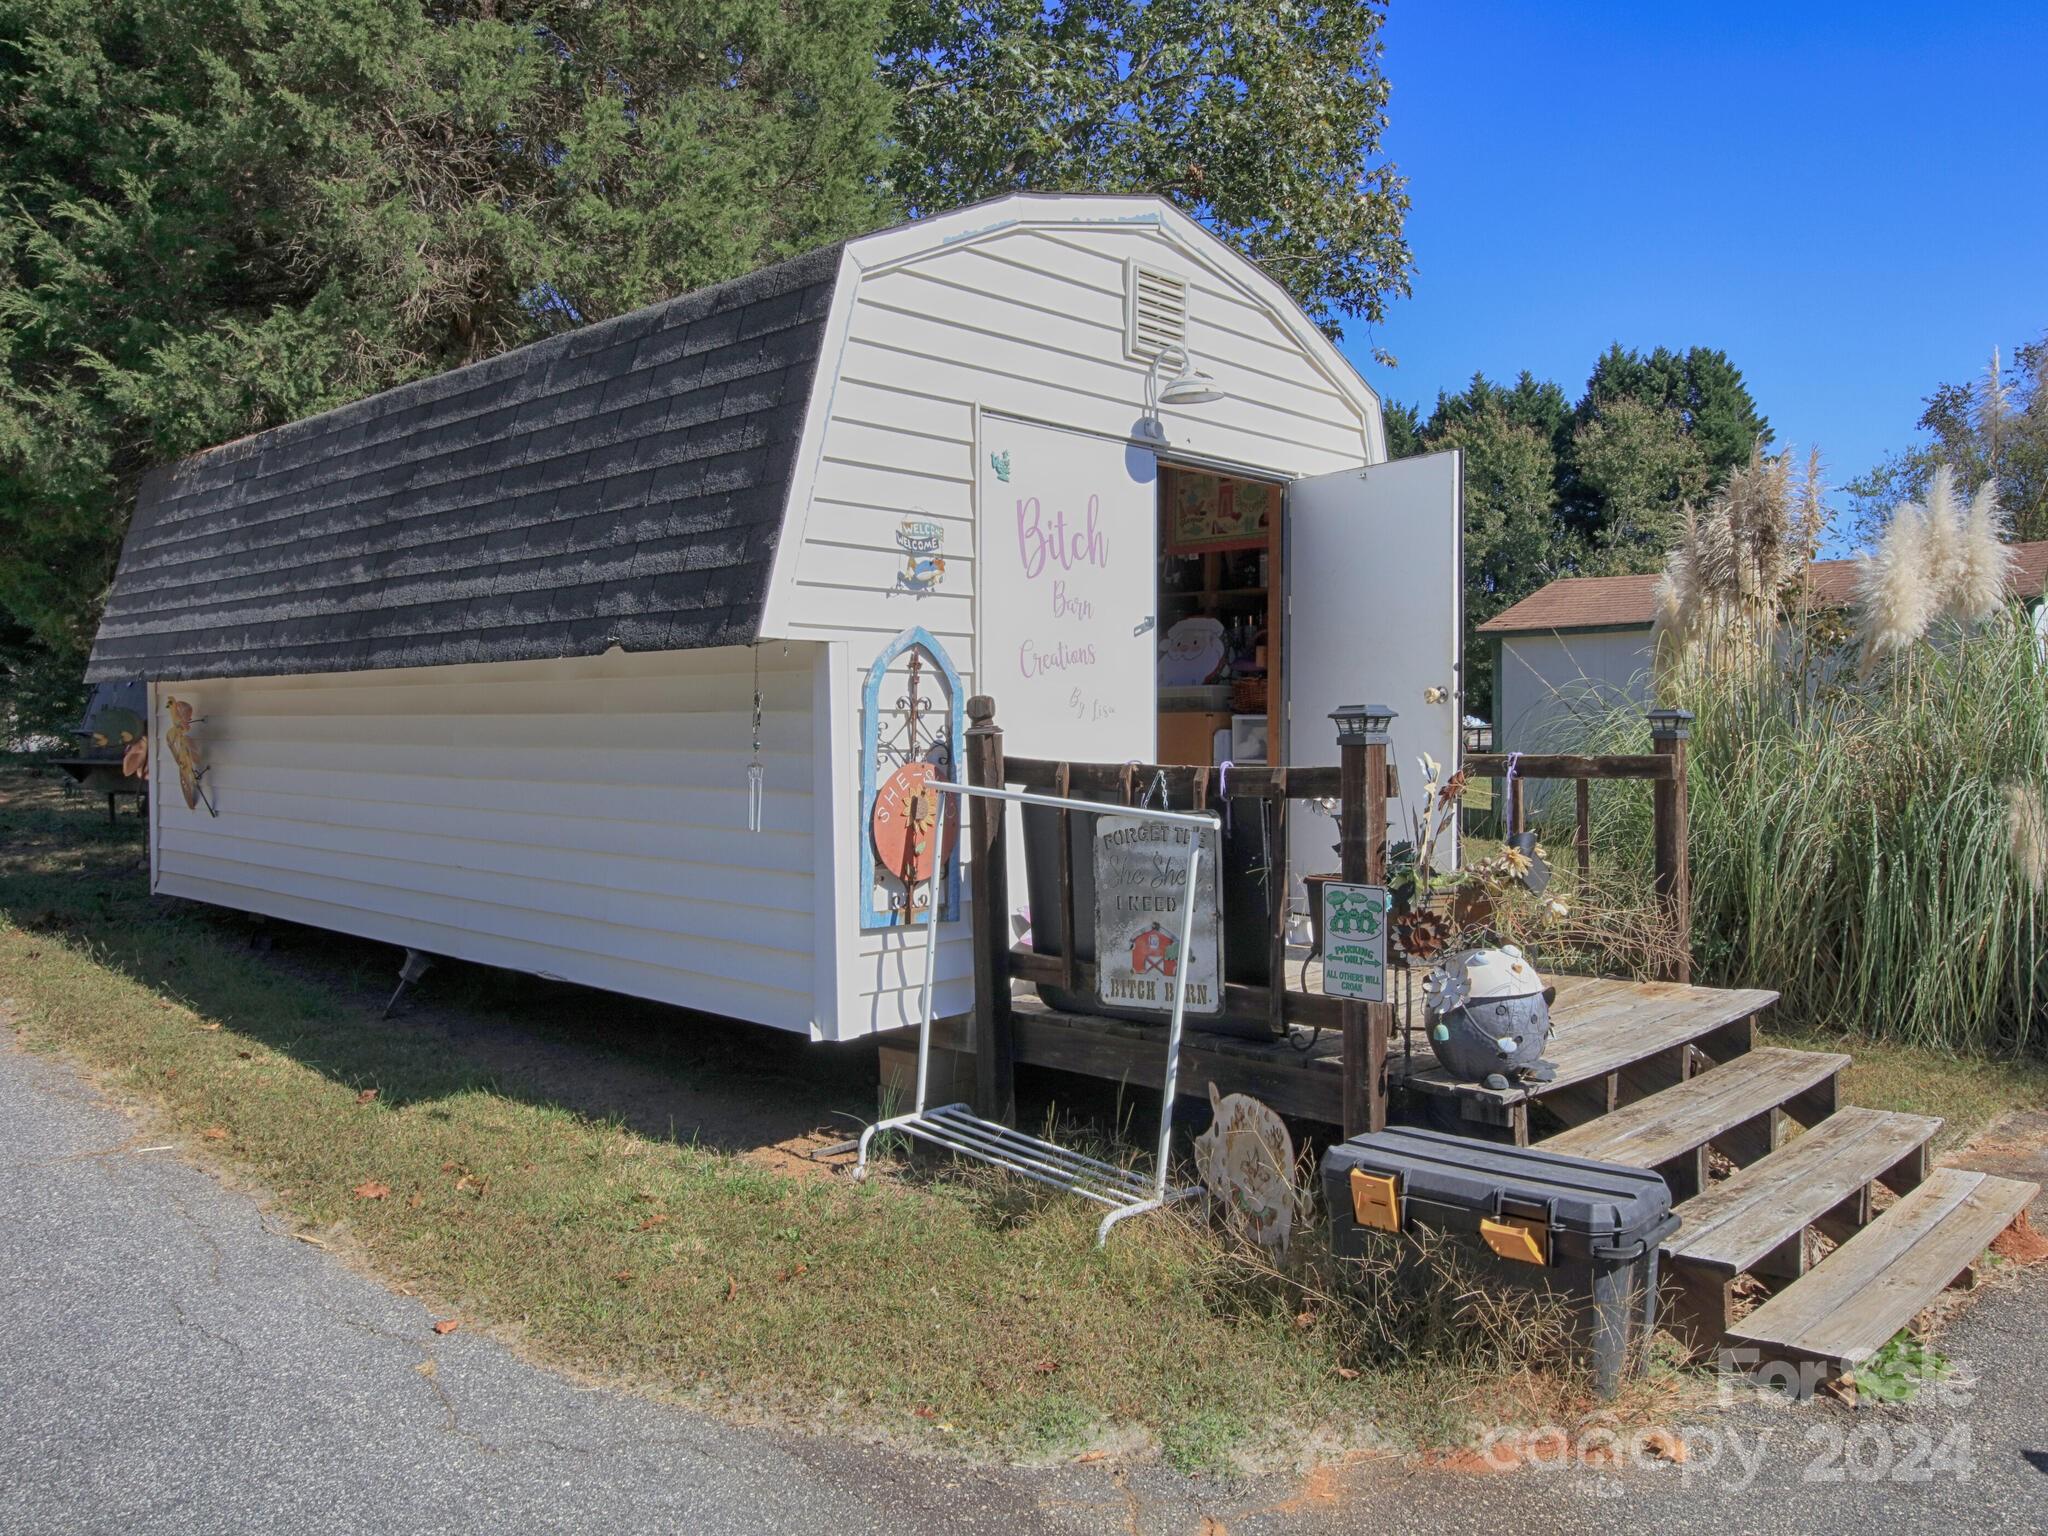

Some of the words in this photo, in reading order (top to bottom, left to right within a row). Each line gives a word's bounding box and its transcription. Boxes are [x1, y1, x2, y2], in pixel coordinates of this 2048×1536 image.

[897, 536, 938, 550] WELCOME
[1016, 494, 1109, 579] Bitch
[1053, 580, 1093, 621] Barn
[1019, 639, 1096, 678] Creations
[1069, 686, 1085, 719] By
[1103, 825, 1170, 850] FORGET
[1109, 854, 1145, 889] She
[1150, 853, 1202, 889] She
[1116, 895, 1121, 911] I
[1128, 895, 1177, 912] NEED
[1335, 945, 1374, 960] PARKING
[1344, 955, 1364, 965] ONLY
[1326, 970, 1338, 979] ALL
[1339, 971, 1364, 983] OTHERS
[1365, 975, 1381, 985] WILL
[1341, 981, 1363, 992] CROAK
[1110, 978, 1156, 1001] BITCH
[1165, 982, 1208, 1005] BRN
